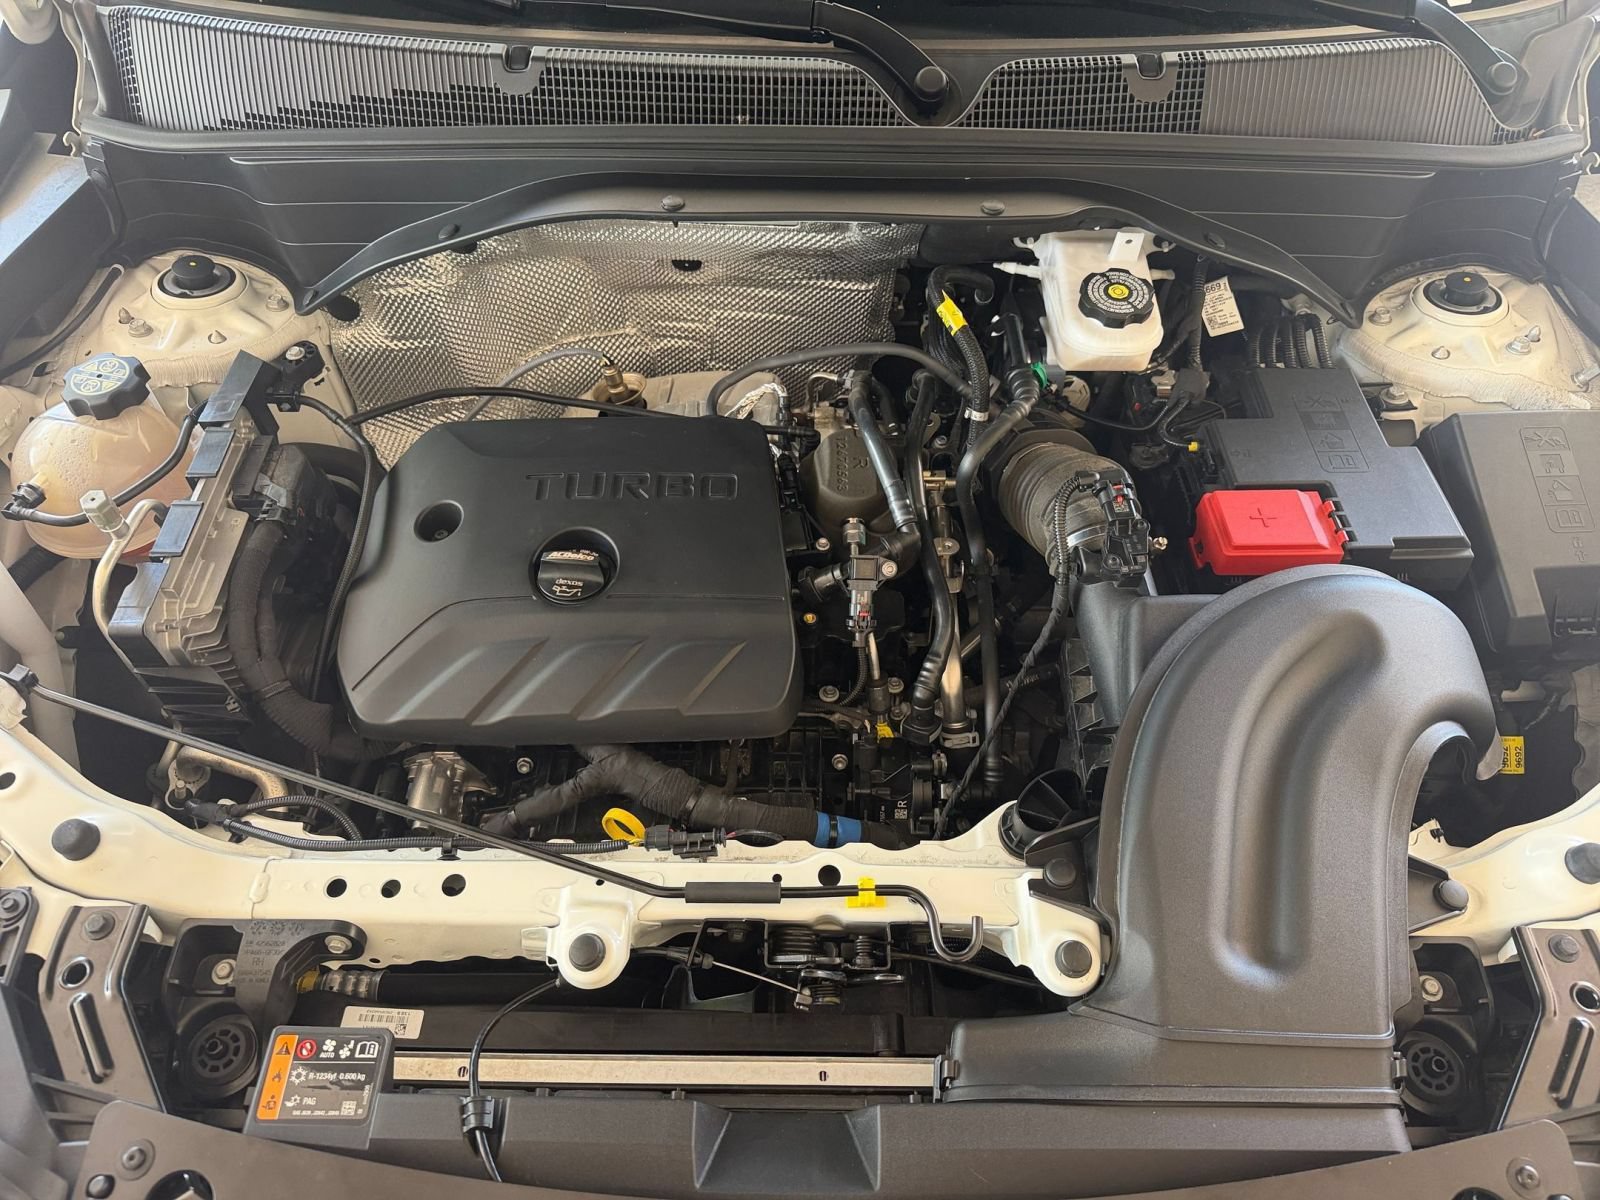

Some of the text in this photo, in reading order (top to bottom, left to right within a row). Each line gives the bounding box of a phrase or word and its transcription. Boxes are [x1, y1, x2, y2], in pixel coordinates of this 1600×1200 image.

[526, 472, 738, 500] TURBO
[546, 551, 595, 561] ACDelco
[555, 578, 584, 587] dexos
[1514, 746, 1522, 768] 9692
[308, 1072, 337, 1082] R-1234yf
[357, 1072, 366, 1082] kg
[302, 1096, 317, 1106] PAG
